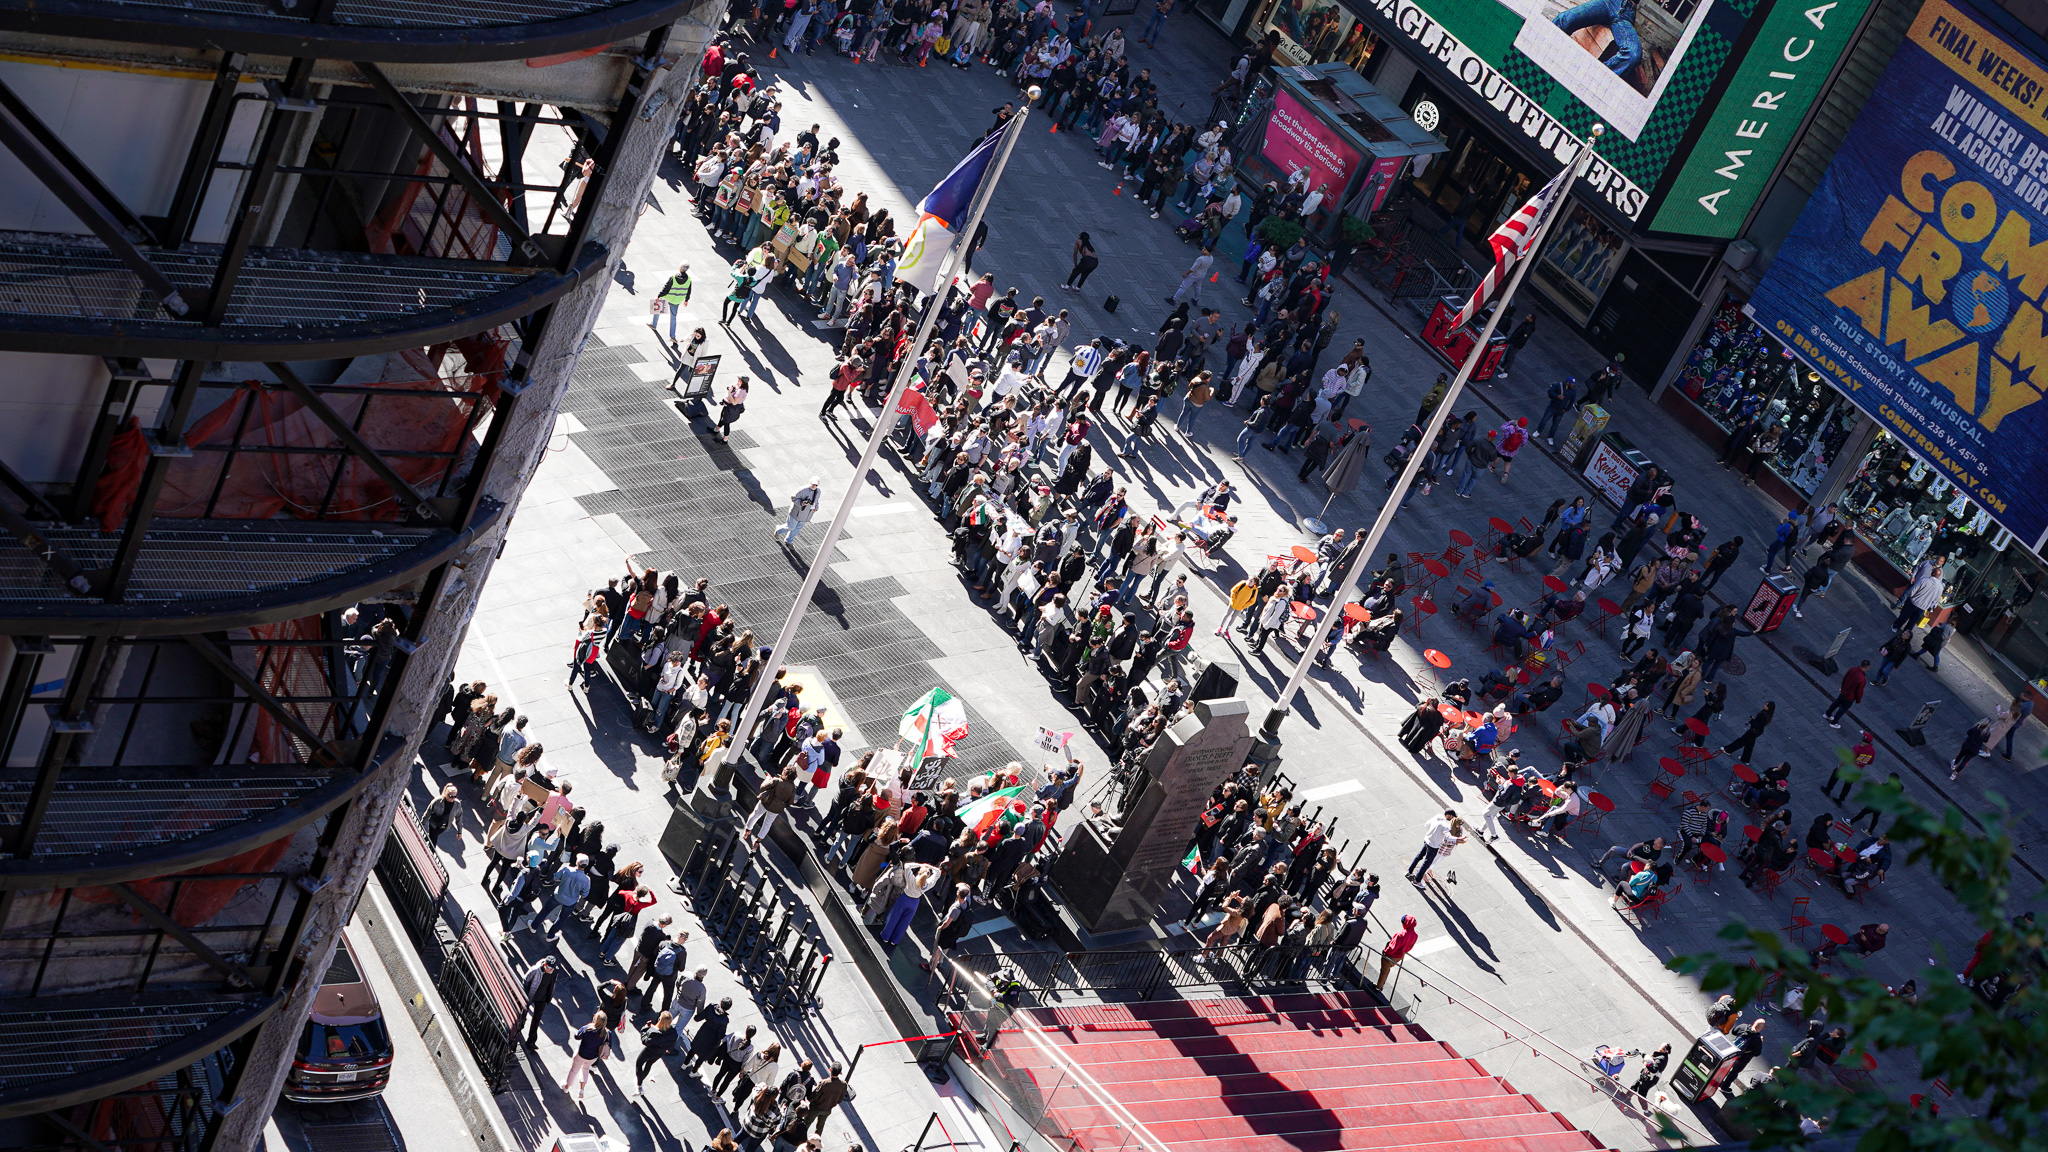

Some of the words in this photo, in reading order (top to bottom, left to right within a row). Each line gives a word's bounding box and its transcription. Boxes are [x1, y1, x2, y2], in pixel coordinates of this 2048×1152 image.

[1371, 0, 1458, 62] AGLE
[1460, 56, 1645, 219] OUTFITTERS
[1698, 2, 1838, 215] AMERICA
[1928, 15, 1978, 65] FINAL
[1976, 47, 2044, 109] WEEKS!
[1271, 114, 1304, 148] Broadway
[1304, 142, 1314, 154] tix.
[1314, 150, 1345, 179] Seriously.
[1278, 109, 1292, 124] Get
[1292, 119, 1304, 133] the
[1302, 129, 1318, 145] best
[1316, 141, 1338, 162] prices
[1337, 157, 1347, 167] on
[1930, 111, 1956, 145] ALL
[1957, 132, 2018, 186] ACROSS
[2014, 174, 2048, 216] NOR
[1945, 84, 2024, 158] WINNER!
[1901, 150, 2048, 313] COM
[1776, 319, 1793, 338] ON
[1793, 334, 1863, 392] BROADWAY
[1824, 266, 2043, 433] AWAY
[1832, 314, 1864, 346] TRUE
[1864, 342, 1905, 381] STORY.
[1907, 377, 1931, 398] HIT
[1930, 395, 1986, 448] MUSICAL.
[1603, 446, 1611, 456] THE
[1819, 332, 1848, 359] Gerald
[1846, 355, 1893, 396] Schoenfeld
[1892, 391, 1926, 427] Theatre,
[1927, 422, 1945, 439] 236
[1945, 436, 1957, 451] W.
[1976, 462, 1989, 477] St.
[1593, 453, 1620, 483] Kinky
[1878, 404, 2007, 514] COMEFROMAWAY.COM
